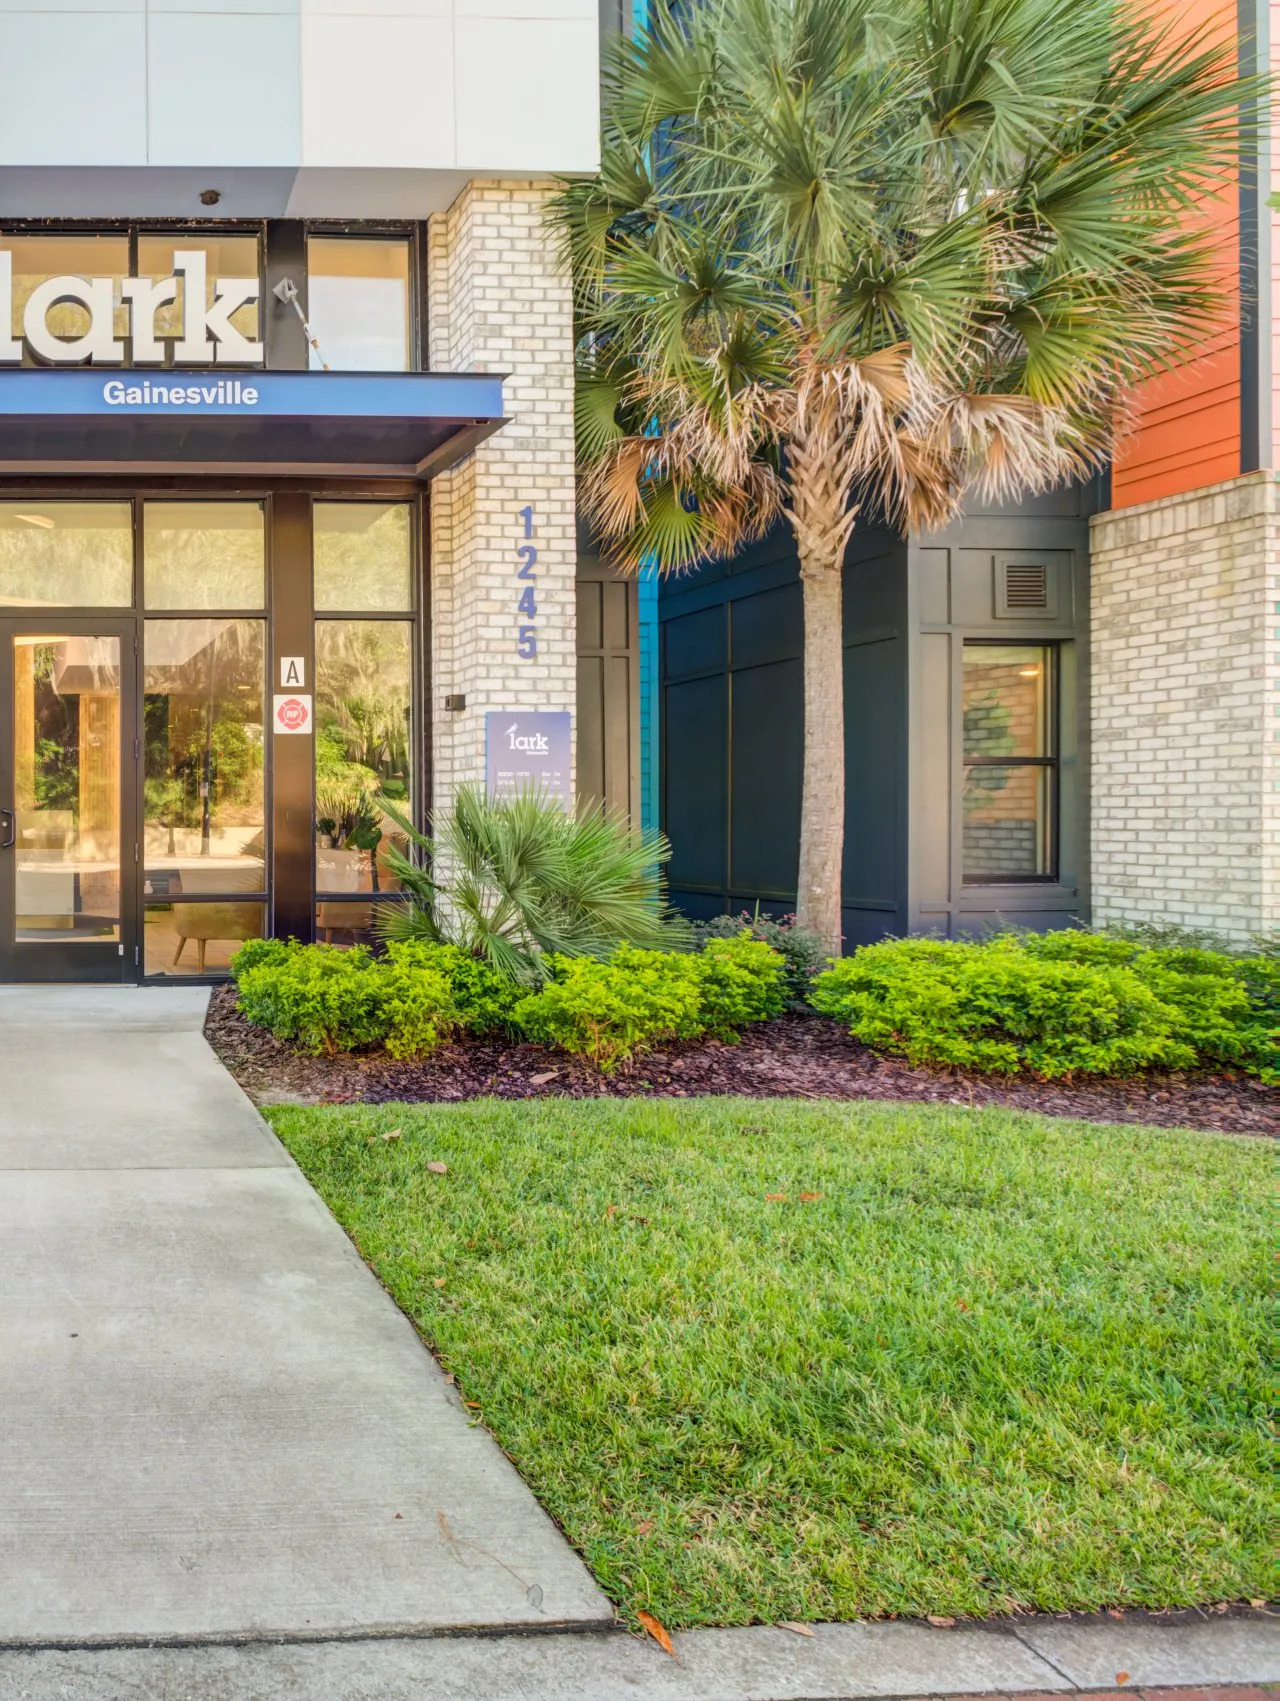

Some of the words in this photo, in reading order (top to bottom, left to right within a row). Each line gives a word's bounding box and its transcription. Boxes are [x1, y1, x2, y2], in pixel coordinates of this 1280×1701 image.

[103, 381, 259, 405] Gainesville
[517, 505, 538, 659] 1245
[285, 660, 300, 684] A
[509, 732, 549, 750] lark
